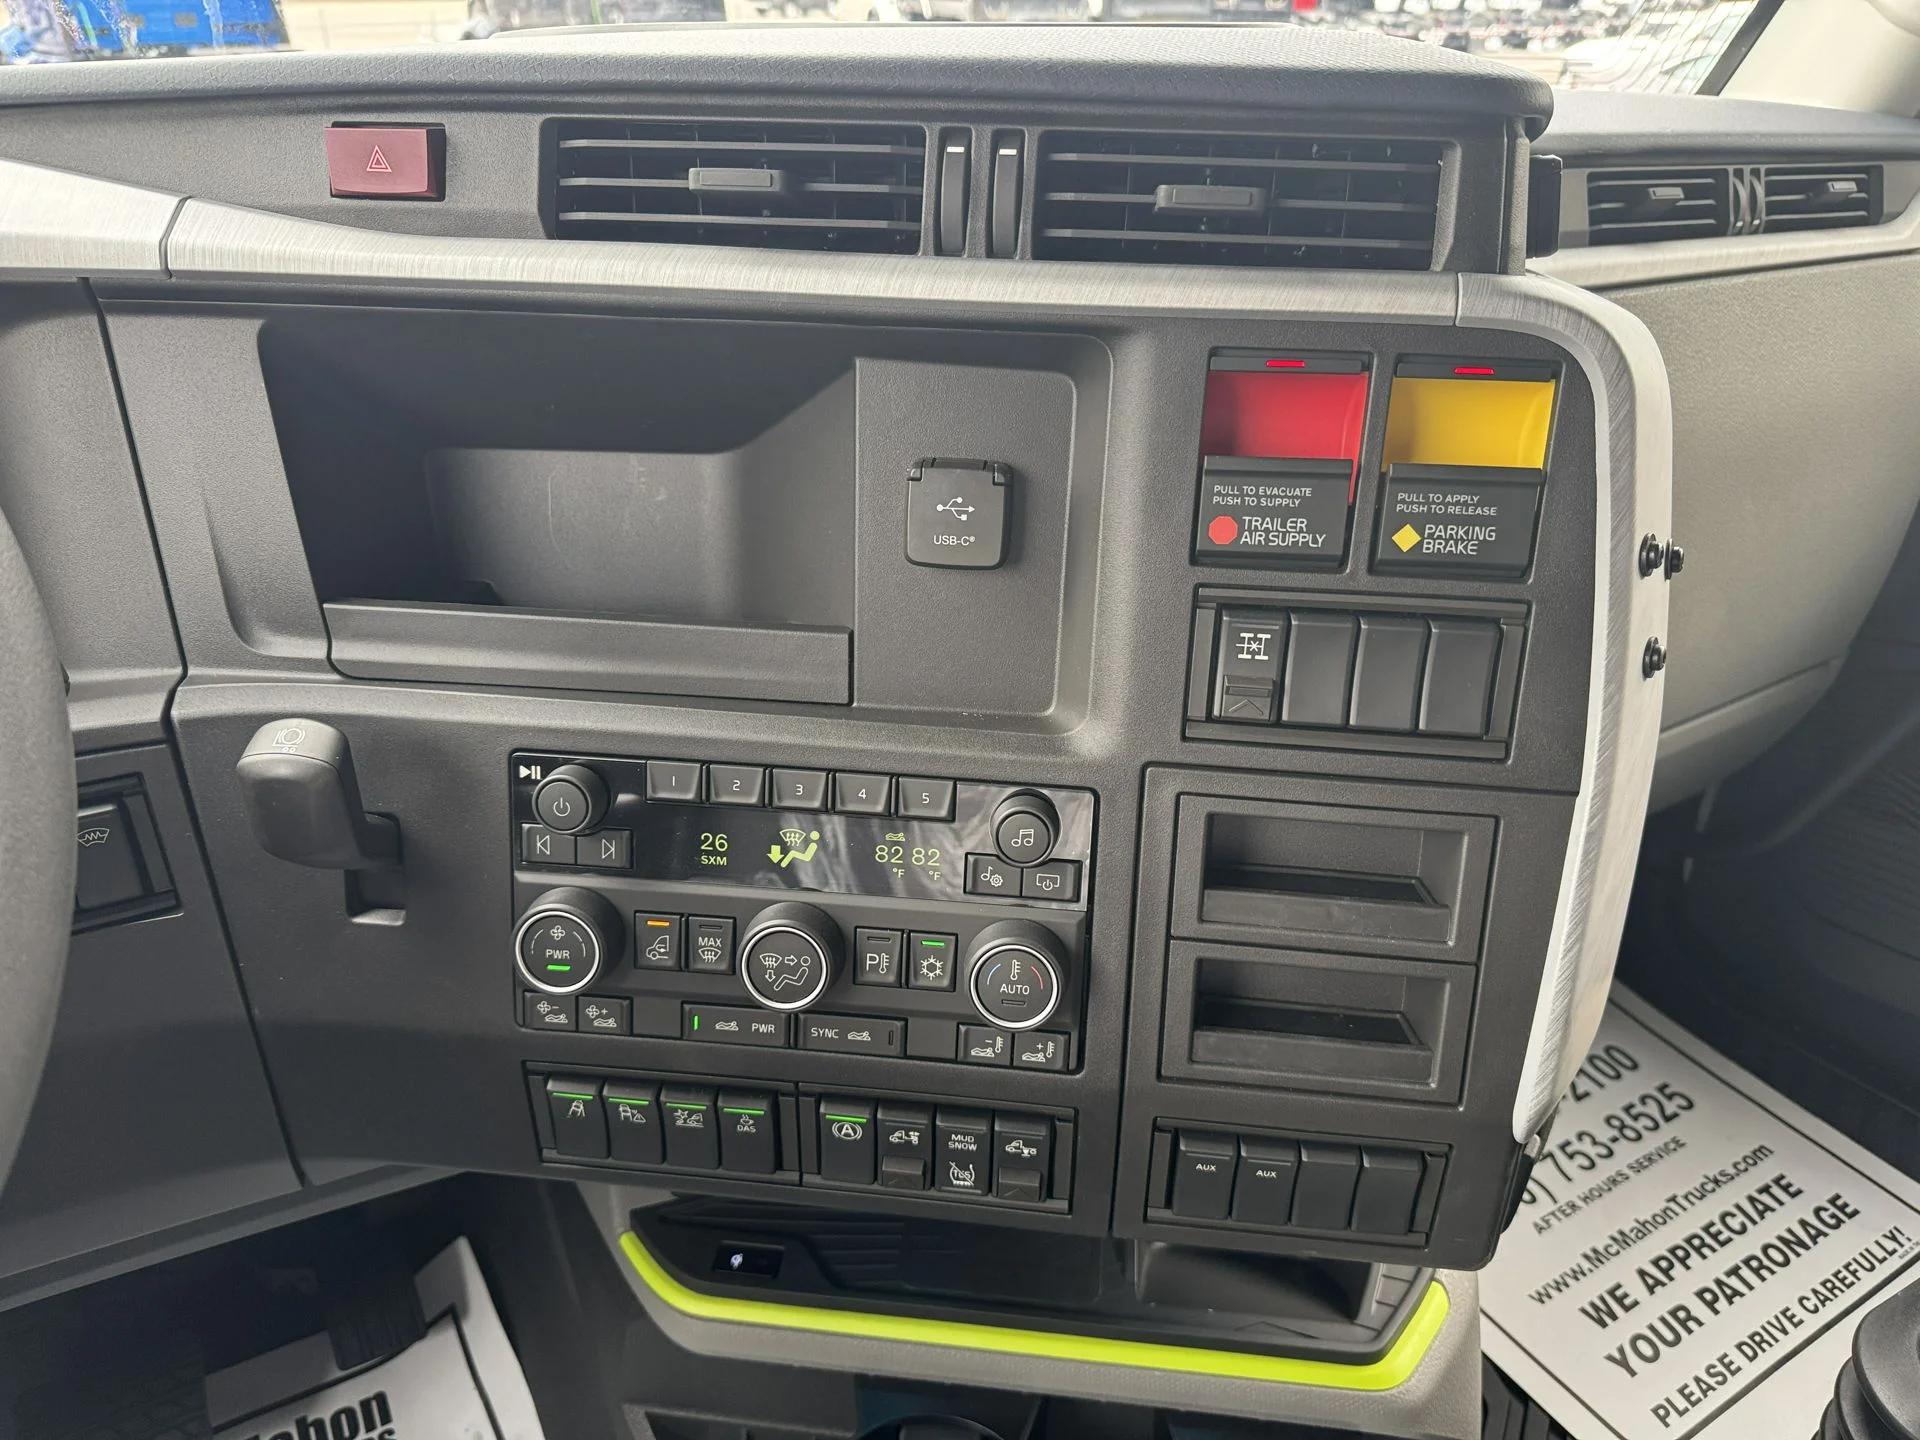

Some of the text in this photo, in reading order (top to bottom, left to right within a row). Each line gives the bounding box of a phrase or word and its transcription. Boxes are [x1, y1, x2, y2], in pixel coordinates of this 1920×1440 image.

[1213, 485, 1312, 497] PULL TO EVACUATE
[1212, 496, 1301, 507] PUSH TO SUPPLY
[1397, 492, 1480, 504] PULL TO APPLY
[1396, 503, 1498, 516] PUSH TO RELEASE
[1242, 516, 1308, 532] TRAILER
[1424, 524, 1496, 541] PARKING
[1240, 531, 1326, 548] AIR SUPPLY
[1422, 539, 1479, 555] BRAKE
[732, 780, 741, 791] 2
[795, 784, 804, 796] 3
[858, 788, 867, 800] 4
[921, 793, 930, 804] 5
[700, 832, 729, 852] 26
[700, 854, 728, 866] SXM
[875, 845, 941, 866] 82 82
[698, 936, 722, 948] MAX
[546, 949, 570, 960] PWR
[1000, 984, 1030, 996] AUTO
[751, 1022, 775, 1034] PWR
[811, 1027, 839, 1039] SYNC
[737, 1124, 756, 1133] DAS
[951, 1134, 975, 1143] MUD
[948, 1141, 978, 1151] SNOW
[1196, 1162, 1216, 1172] AUX
[1256, 1169, 1277, 1179] AUX
[1532, 1135, 1688, 1236] AFTER HOURS SERVICE
[1527, 1144, 1776, 1306] www.McMahonTrucks.com
[1578, 1172, 1804, 1330] WE APPRECIATE
[1603, 1192, 1861, 1379] YOUR PATRONAGE
[1649, 1225, 1912, 1429] PLEASE DRIVE CAREFULLY!
